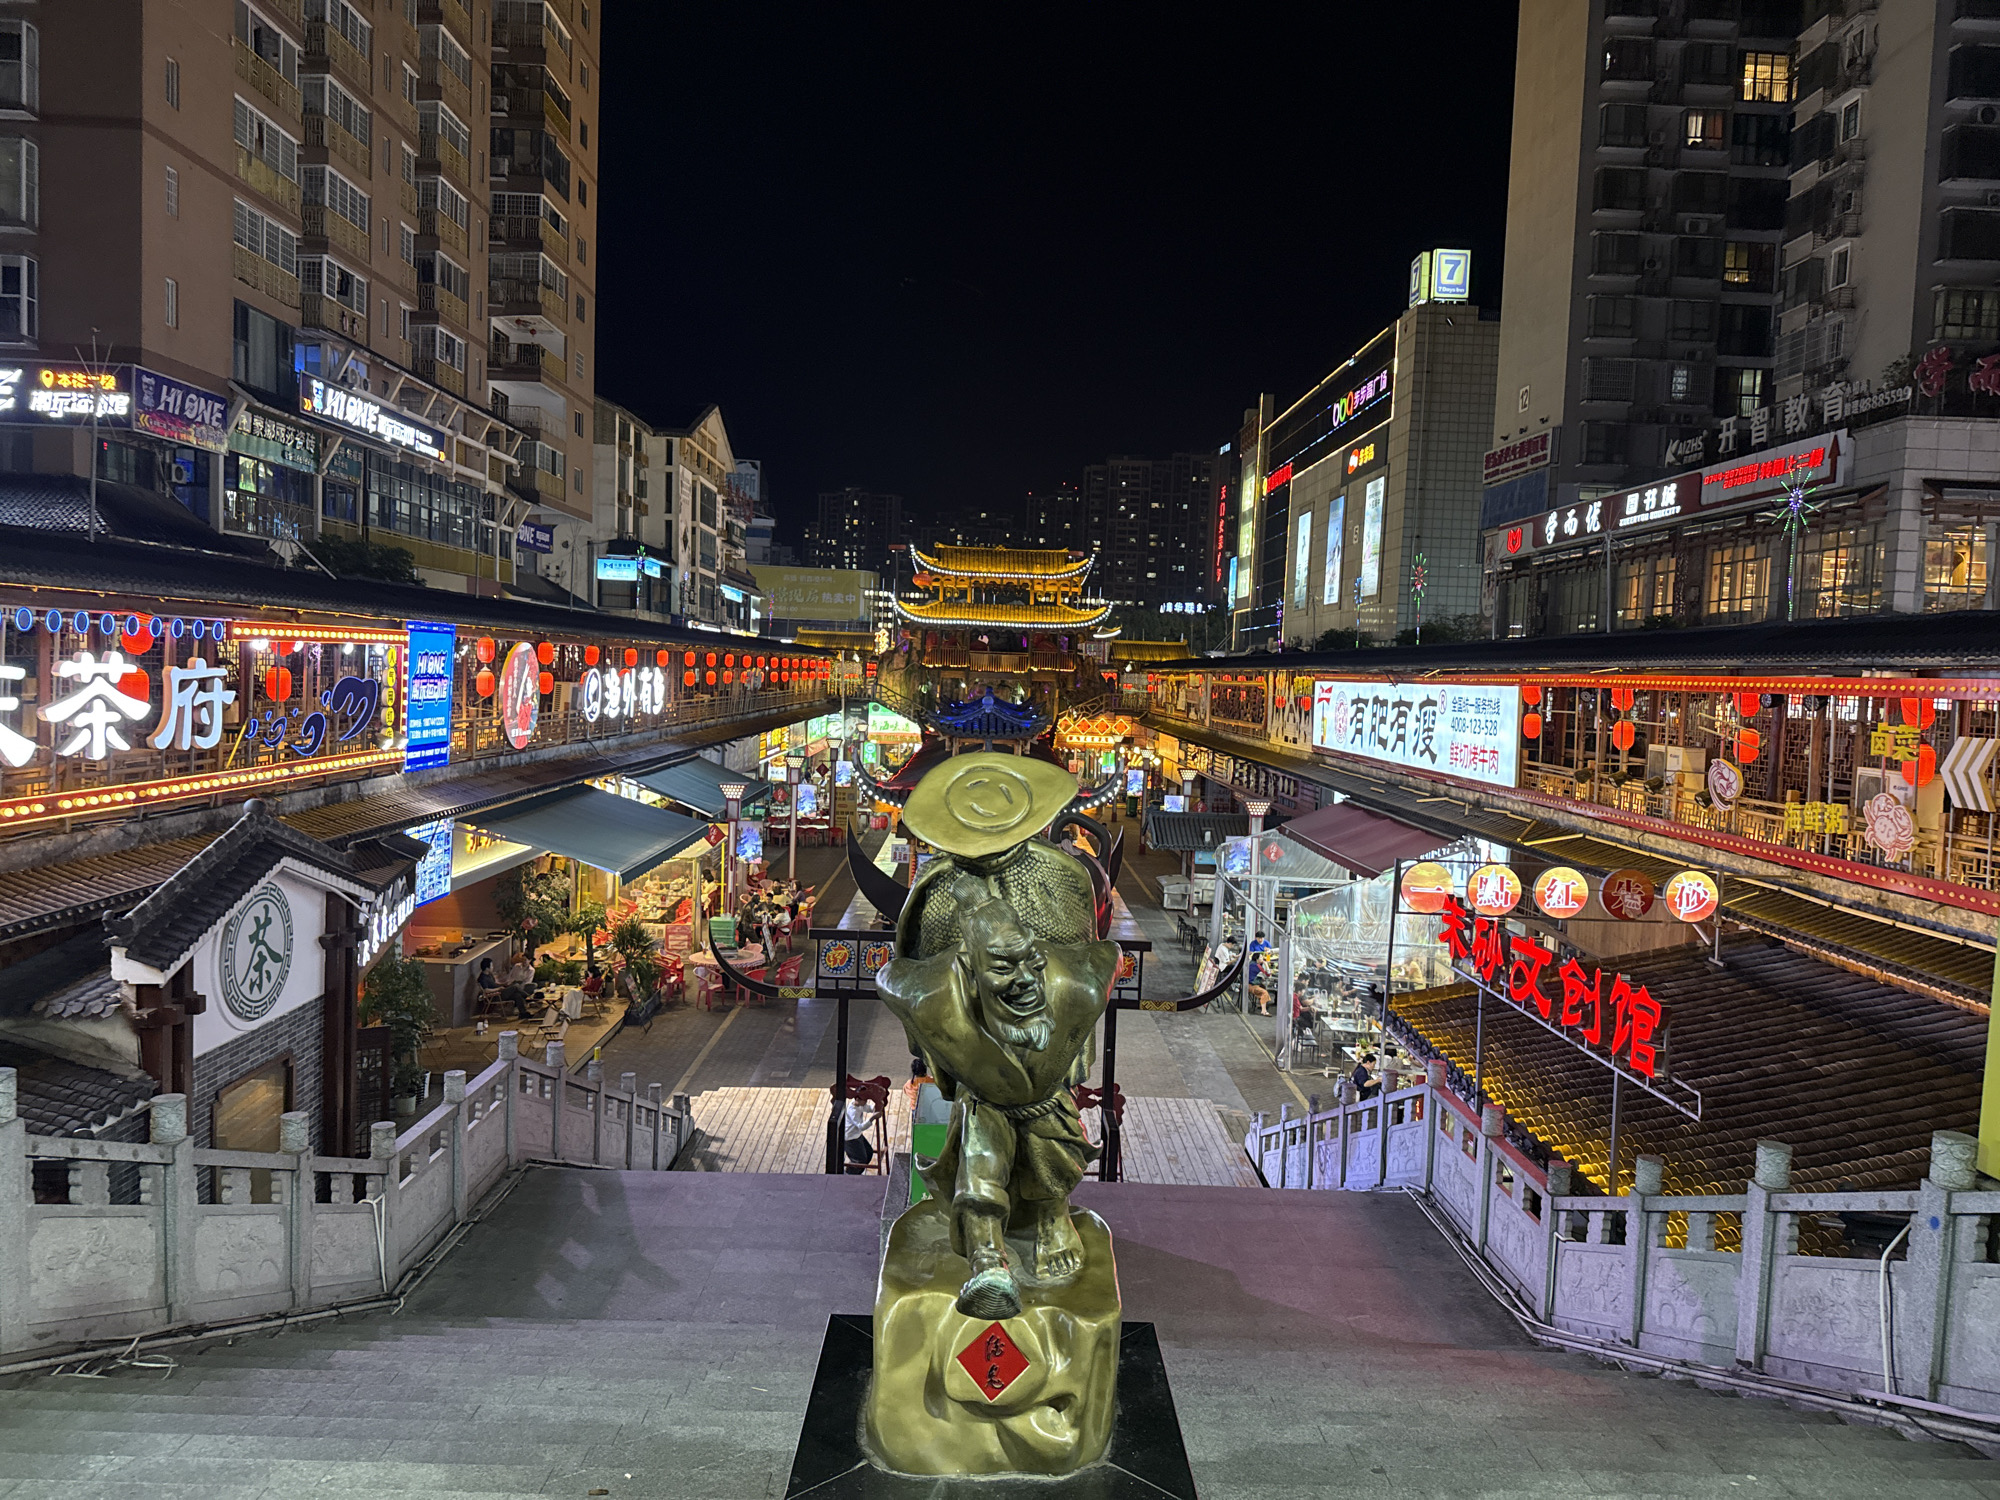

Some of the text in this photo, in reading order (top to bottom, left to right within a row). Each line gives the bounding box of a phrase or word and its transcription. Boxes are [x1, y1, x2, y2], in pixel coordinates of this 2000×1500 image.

[1442, 286, 1455, 294] Days
[1445, 260, 1461, 280] 7
[156, 384, 226, 429] HI ONE
[323, 388, 380, 434] HI ONE
[1353, 369, 1387, 410] 步步高广场
[253, 414, 316, 454] 蒙娜丽莎瓷砖
[1718, 381, 1846, 453] 开智教育
[1545, 483, 1678, 545] 学而优 图书城
[428, 654, 446, 674] ONE
[1350, 693, 1438, 765] 有肥有瘦
[1450, 716, 1498, 737] 4008-123-528
[1449, 741, 1499, 775] 鲜切烤牛肉
[240, 904, 284, 994] 茶
[1438, 894, 1662, 1079] 朱砂文创馆
